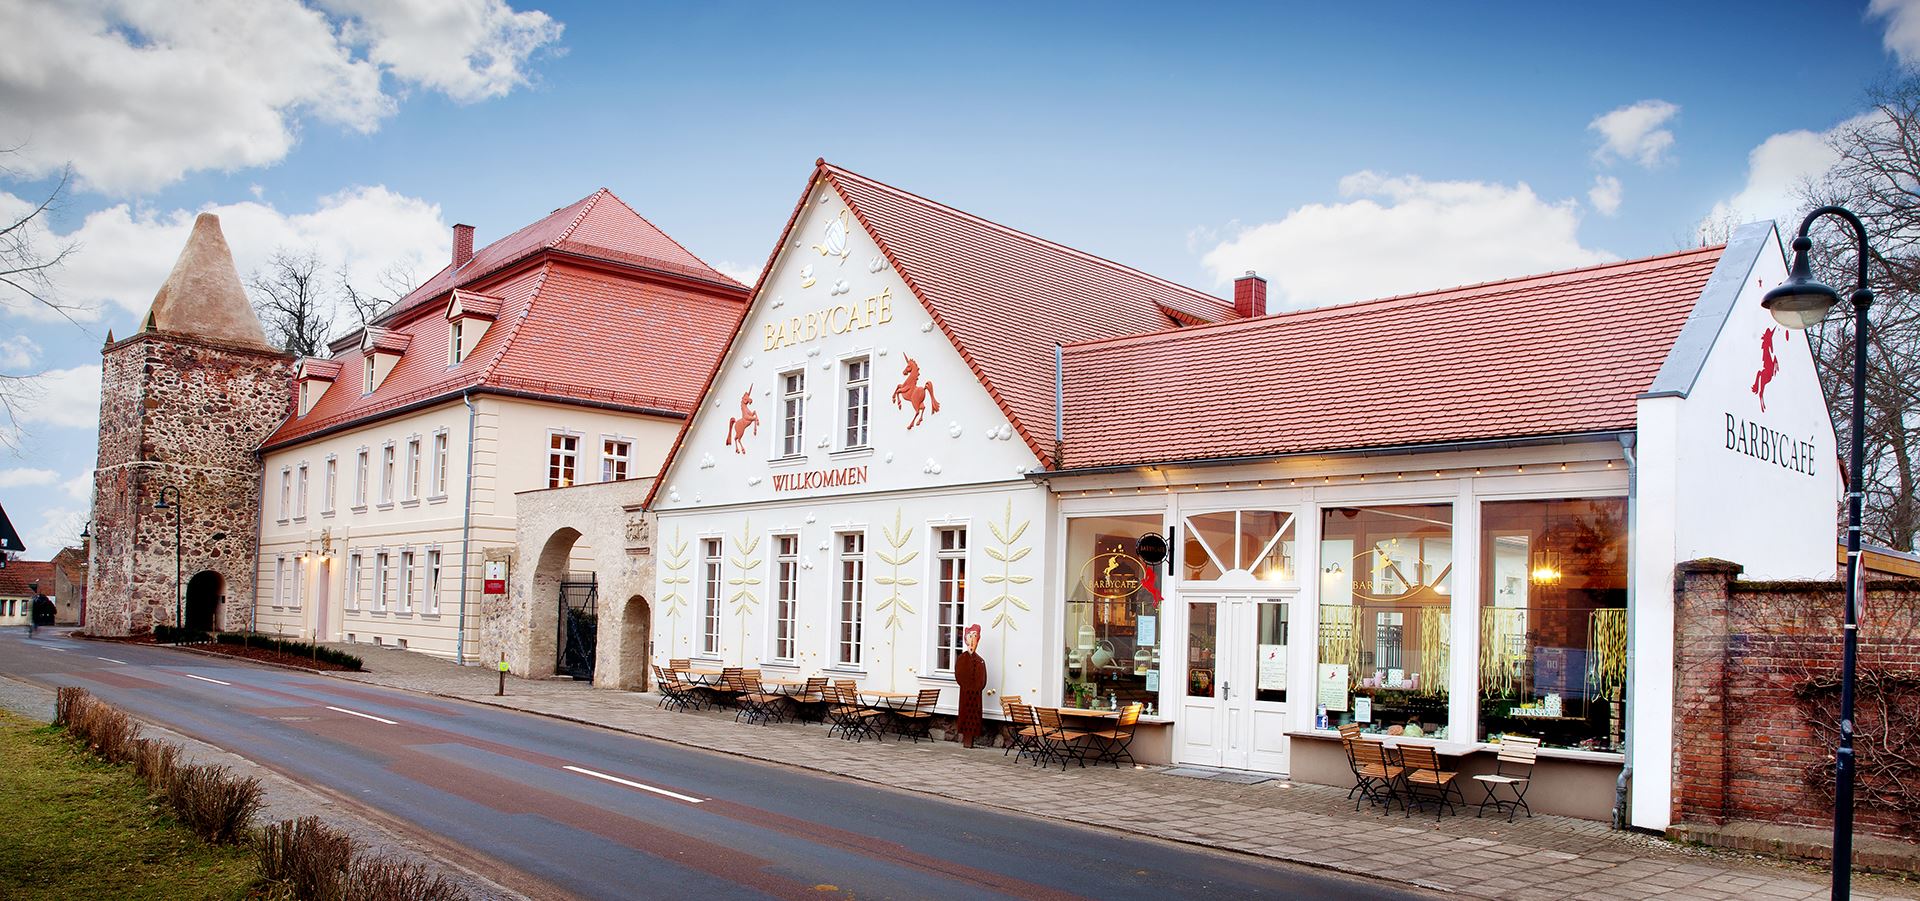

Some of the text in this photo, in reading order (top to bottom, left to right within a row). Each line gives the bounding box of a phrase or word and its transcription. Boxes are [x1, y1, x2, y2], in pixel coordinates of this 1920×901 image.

[764, 287, 893, 352] BARBYCAFÉ
[1724, 411, 1815, 477] BARBYCAFÉ
[772, 465, 868, 492] WILLKOMMEN
